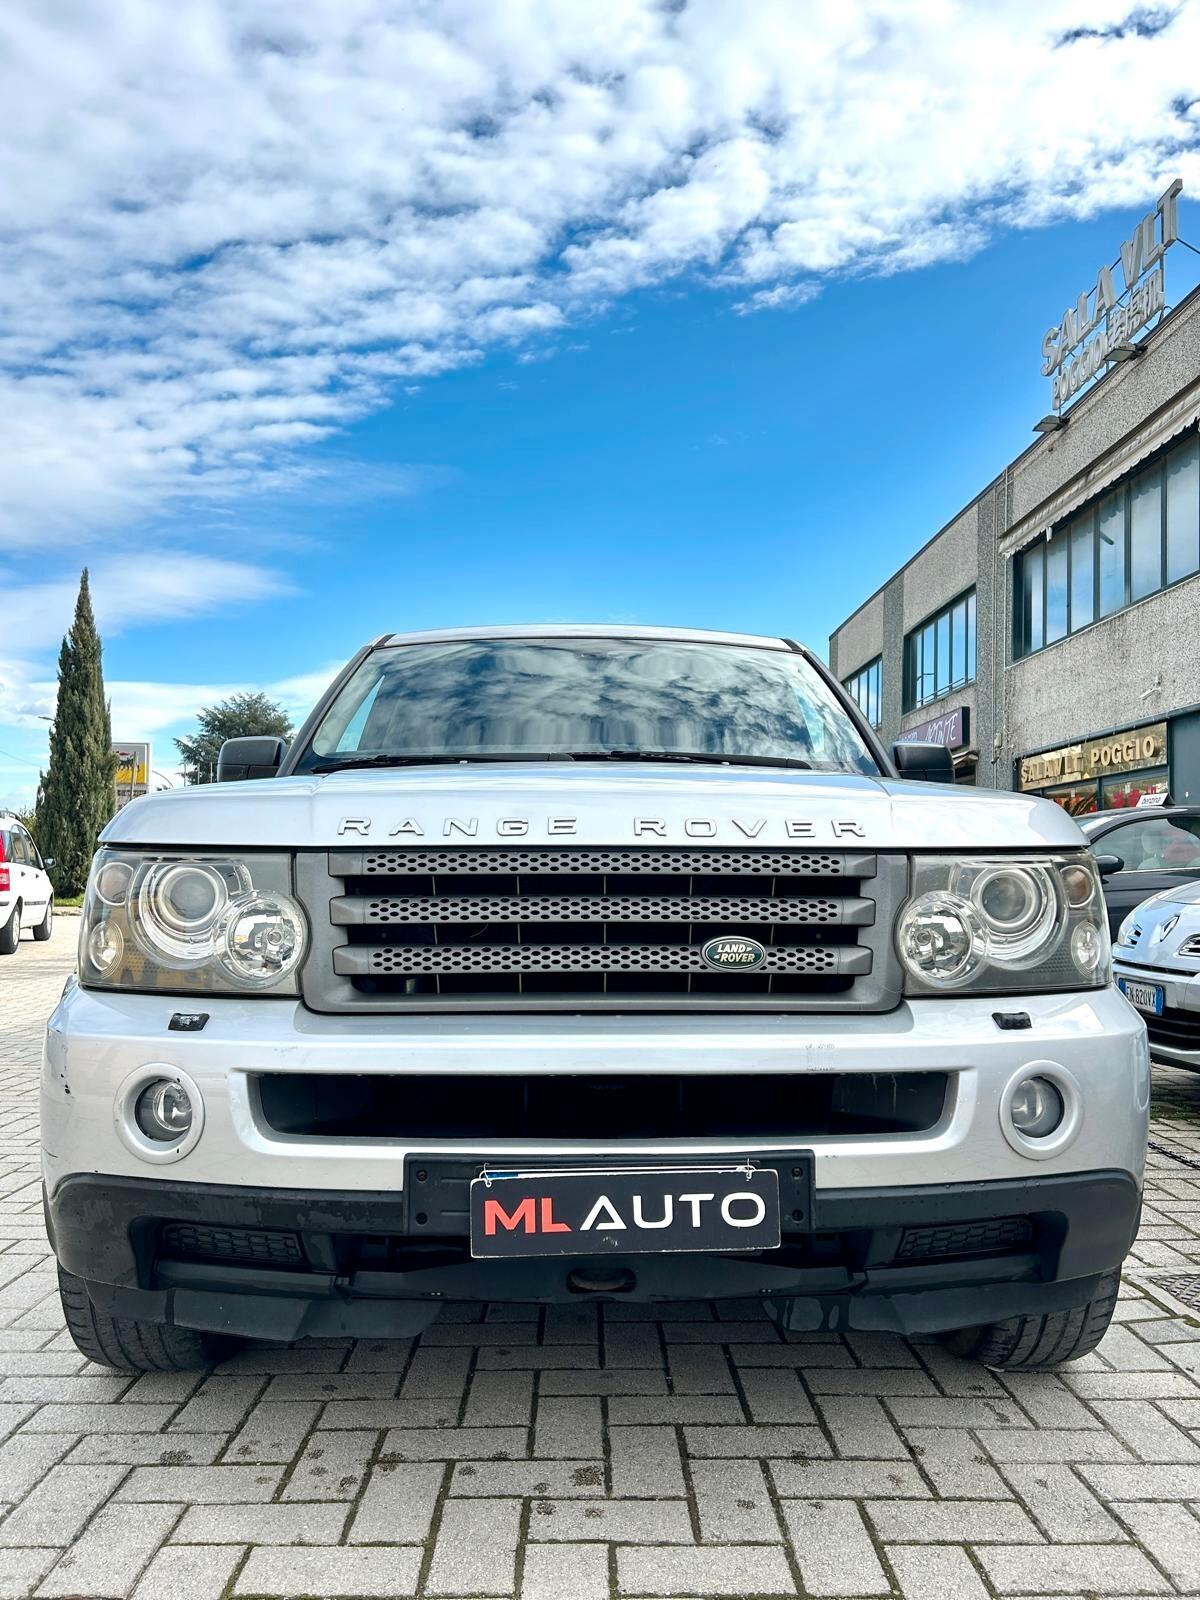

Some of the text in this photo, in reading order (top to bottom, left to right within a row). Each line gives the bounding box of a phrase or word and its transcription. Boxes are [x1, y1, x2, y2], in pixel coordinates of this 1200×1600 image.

[1041, 178, 1184, 377] SALA VLT
[1052, 332, 1109, 411] POGGIO
[1090, 735, 1156, 769] POGGIO
[337, 816, 866, 838] RANGE ROVER
[717, 944, 746, 953] LAND
[720, 953, 755, 962] ROVER
[484, 1192, 766, 1236] ML AUTO
